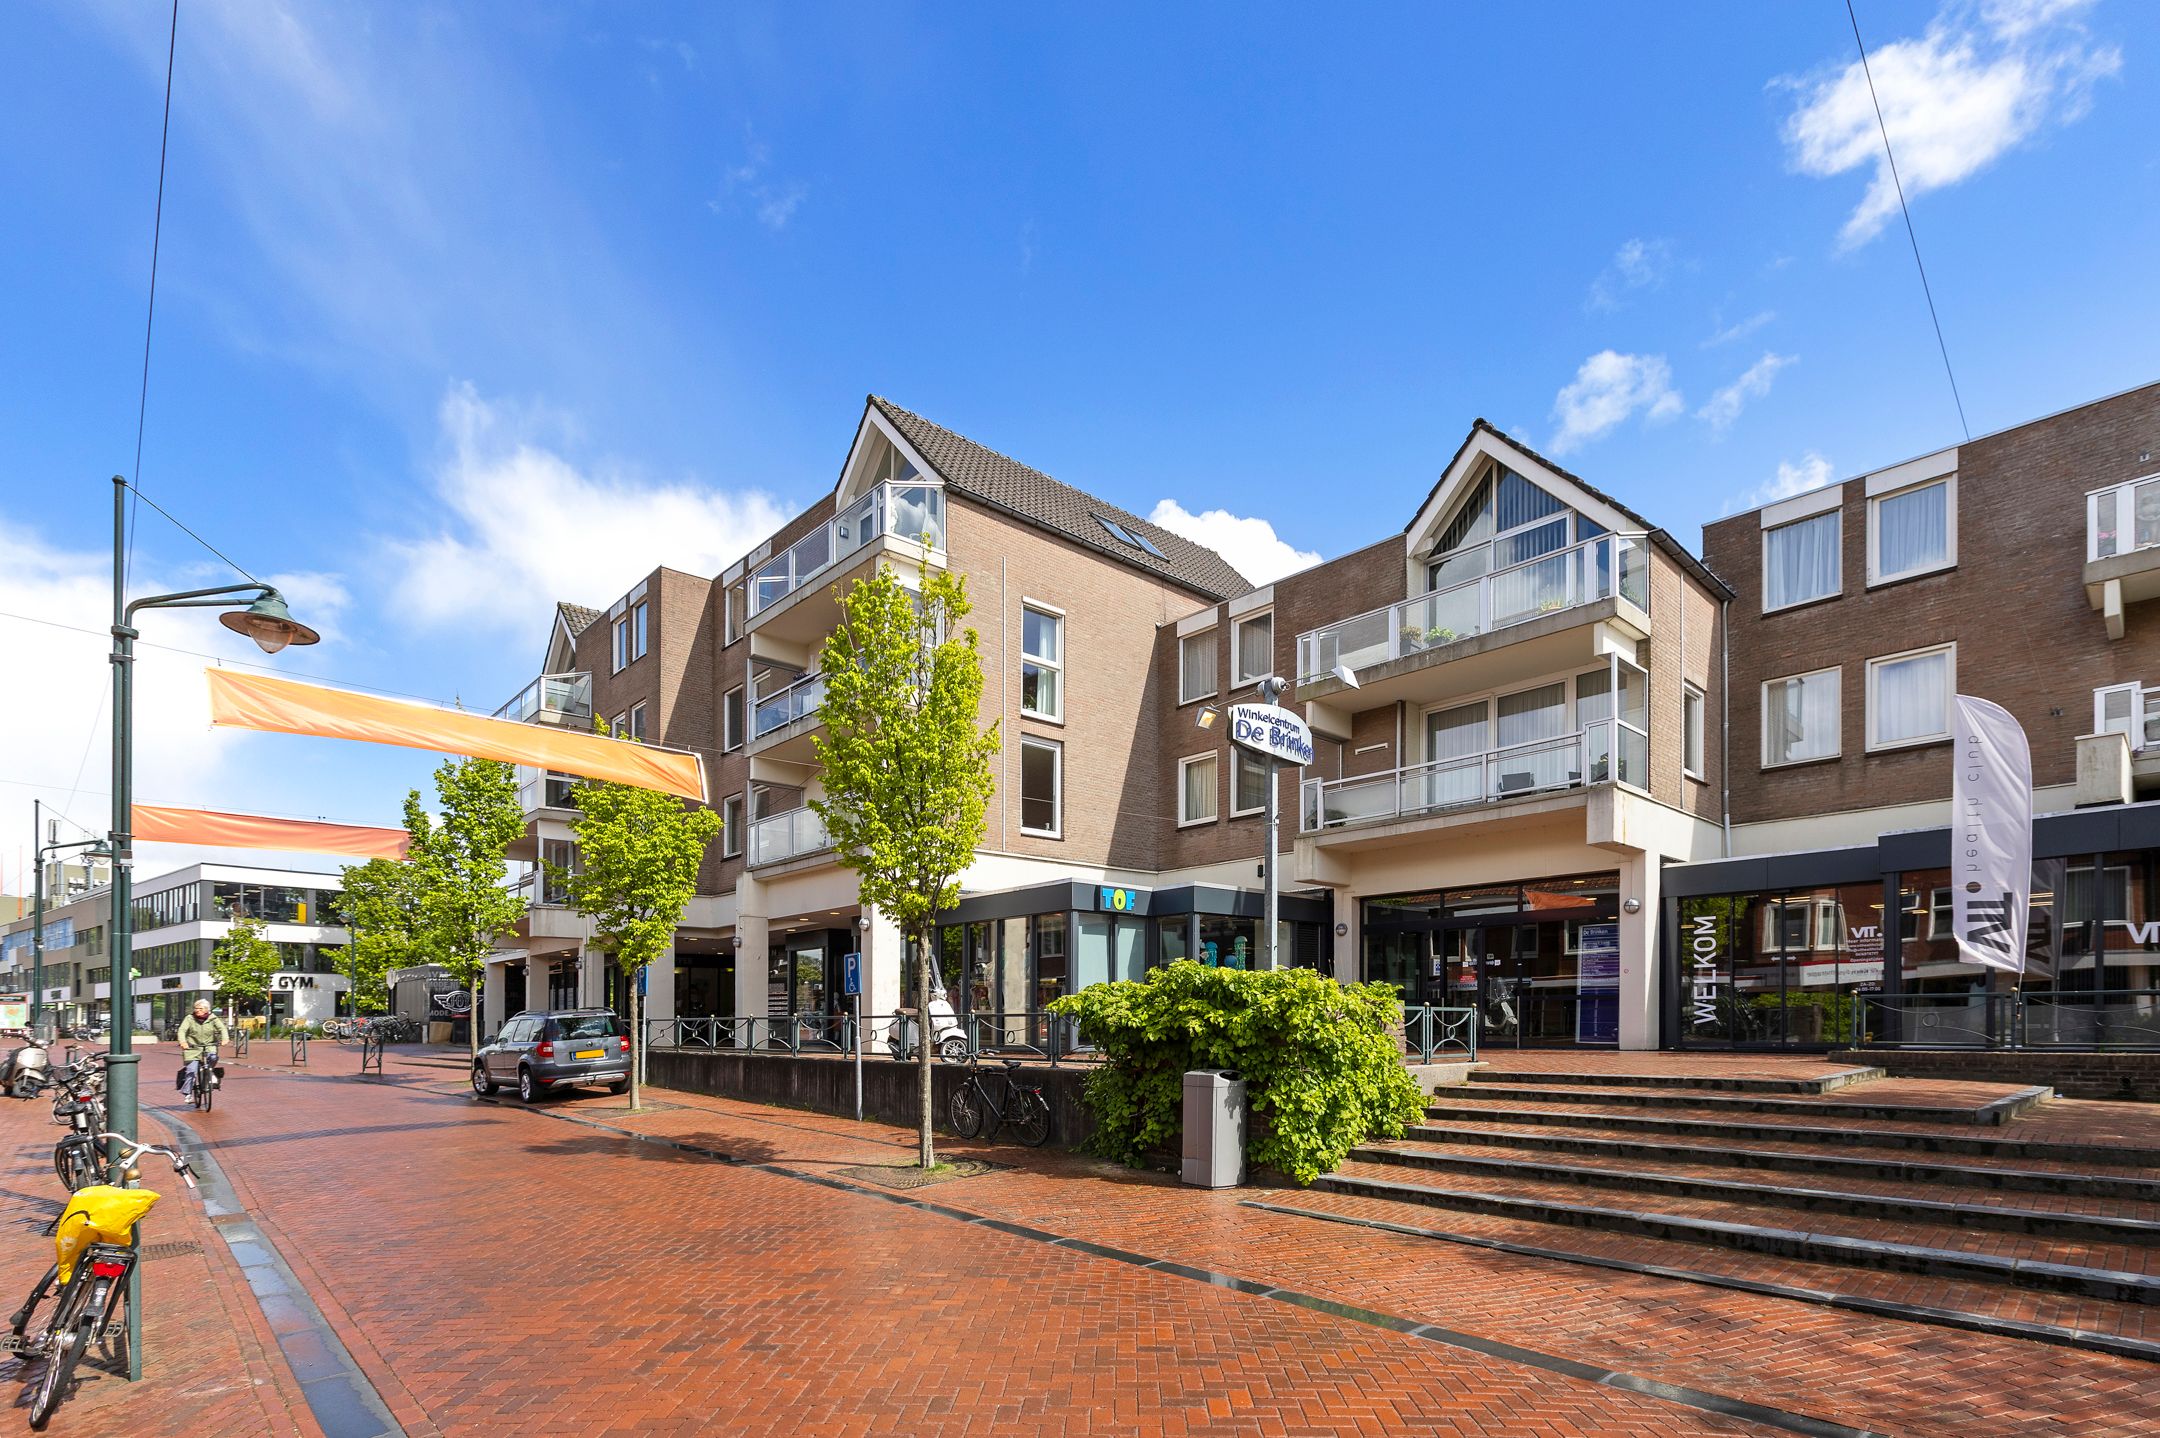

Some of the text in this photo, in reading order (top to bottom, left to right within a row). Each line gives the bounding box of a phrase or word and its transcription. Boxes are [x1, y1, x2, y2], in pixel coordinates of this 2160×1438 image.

[1237, 706, 1300, 735] Winkelcentrum
[1236, 719, 1315, 762] De Brinken
[1102, 887, 1136, 911] TOF
[2126, 921, 2160, 944] VI
[847, 957, 856, 977] P
[1693, 916, 1717, 1025] WELKOM
